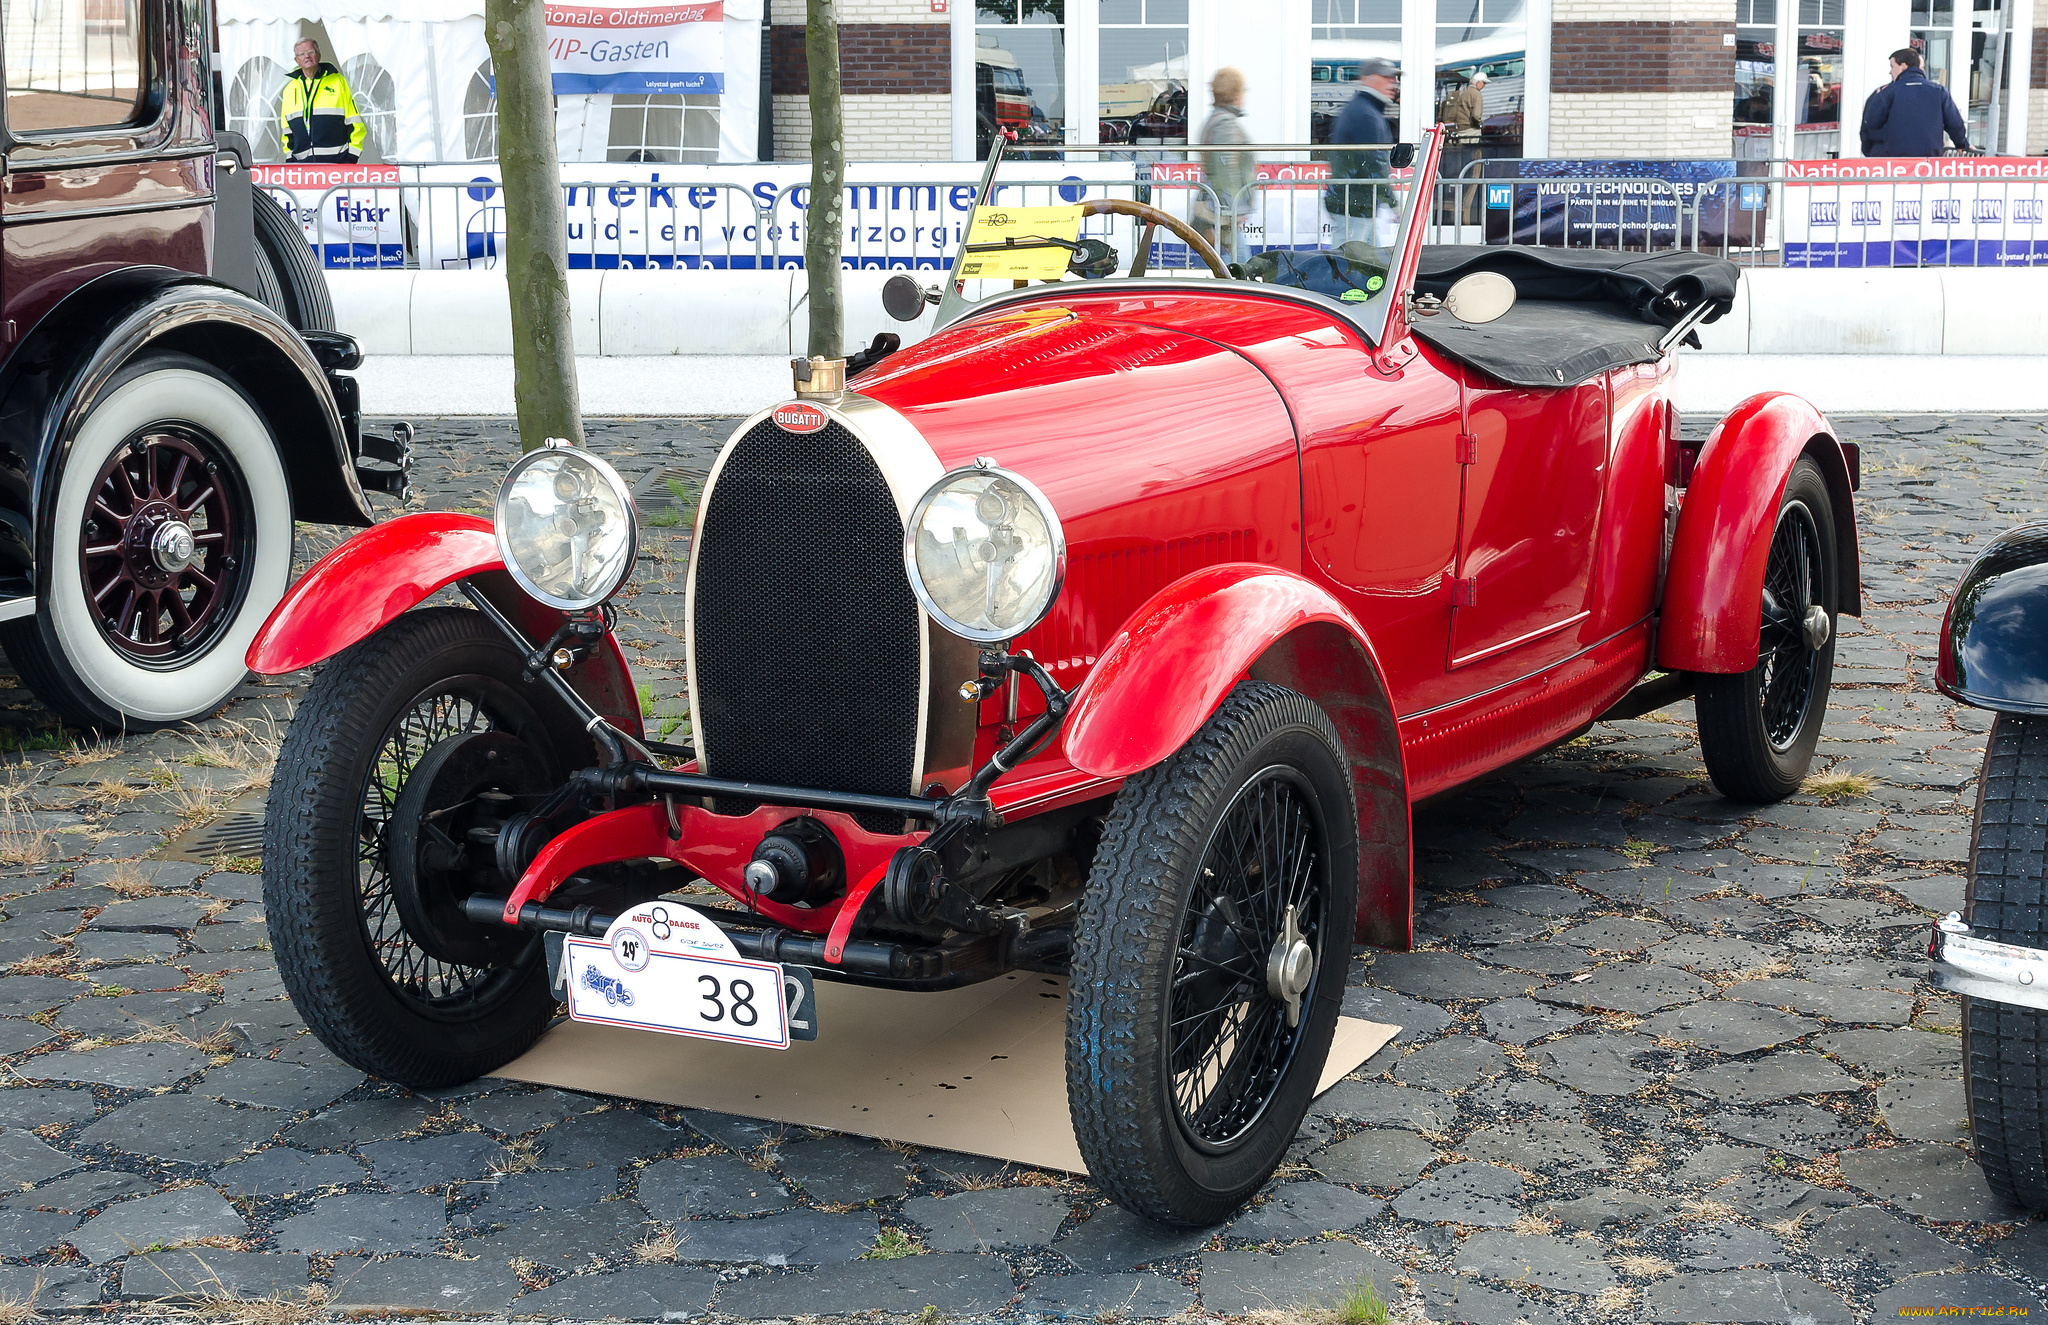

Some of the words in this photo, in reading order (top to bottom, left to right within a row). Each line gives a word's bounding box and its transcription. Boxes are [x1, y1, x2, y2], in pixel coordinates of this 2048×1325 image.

[545, 8, 603, 25] ionale
[608, 8, 706, 26] Oldtimerdag
[1787, 162, 1907, 178] Nationale
[567, 173, 718, 209] neke
[1490, 188, 1510, 204] MT
[1537, 182, 1581, 195] MUCO
[336, 196, 391, 222] Fisher
[352, 224, 374, 232] Farma
[568, 218, 639, 241] uid-
[660, 224, 701, 242] en
[777, 411, 821, 427] BUGATTI
[631, 915, 652, 924] AUTO
[669, 919, 700, 930] DAAGSE
[697, 974, 758, 1027] 38
